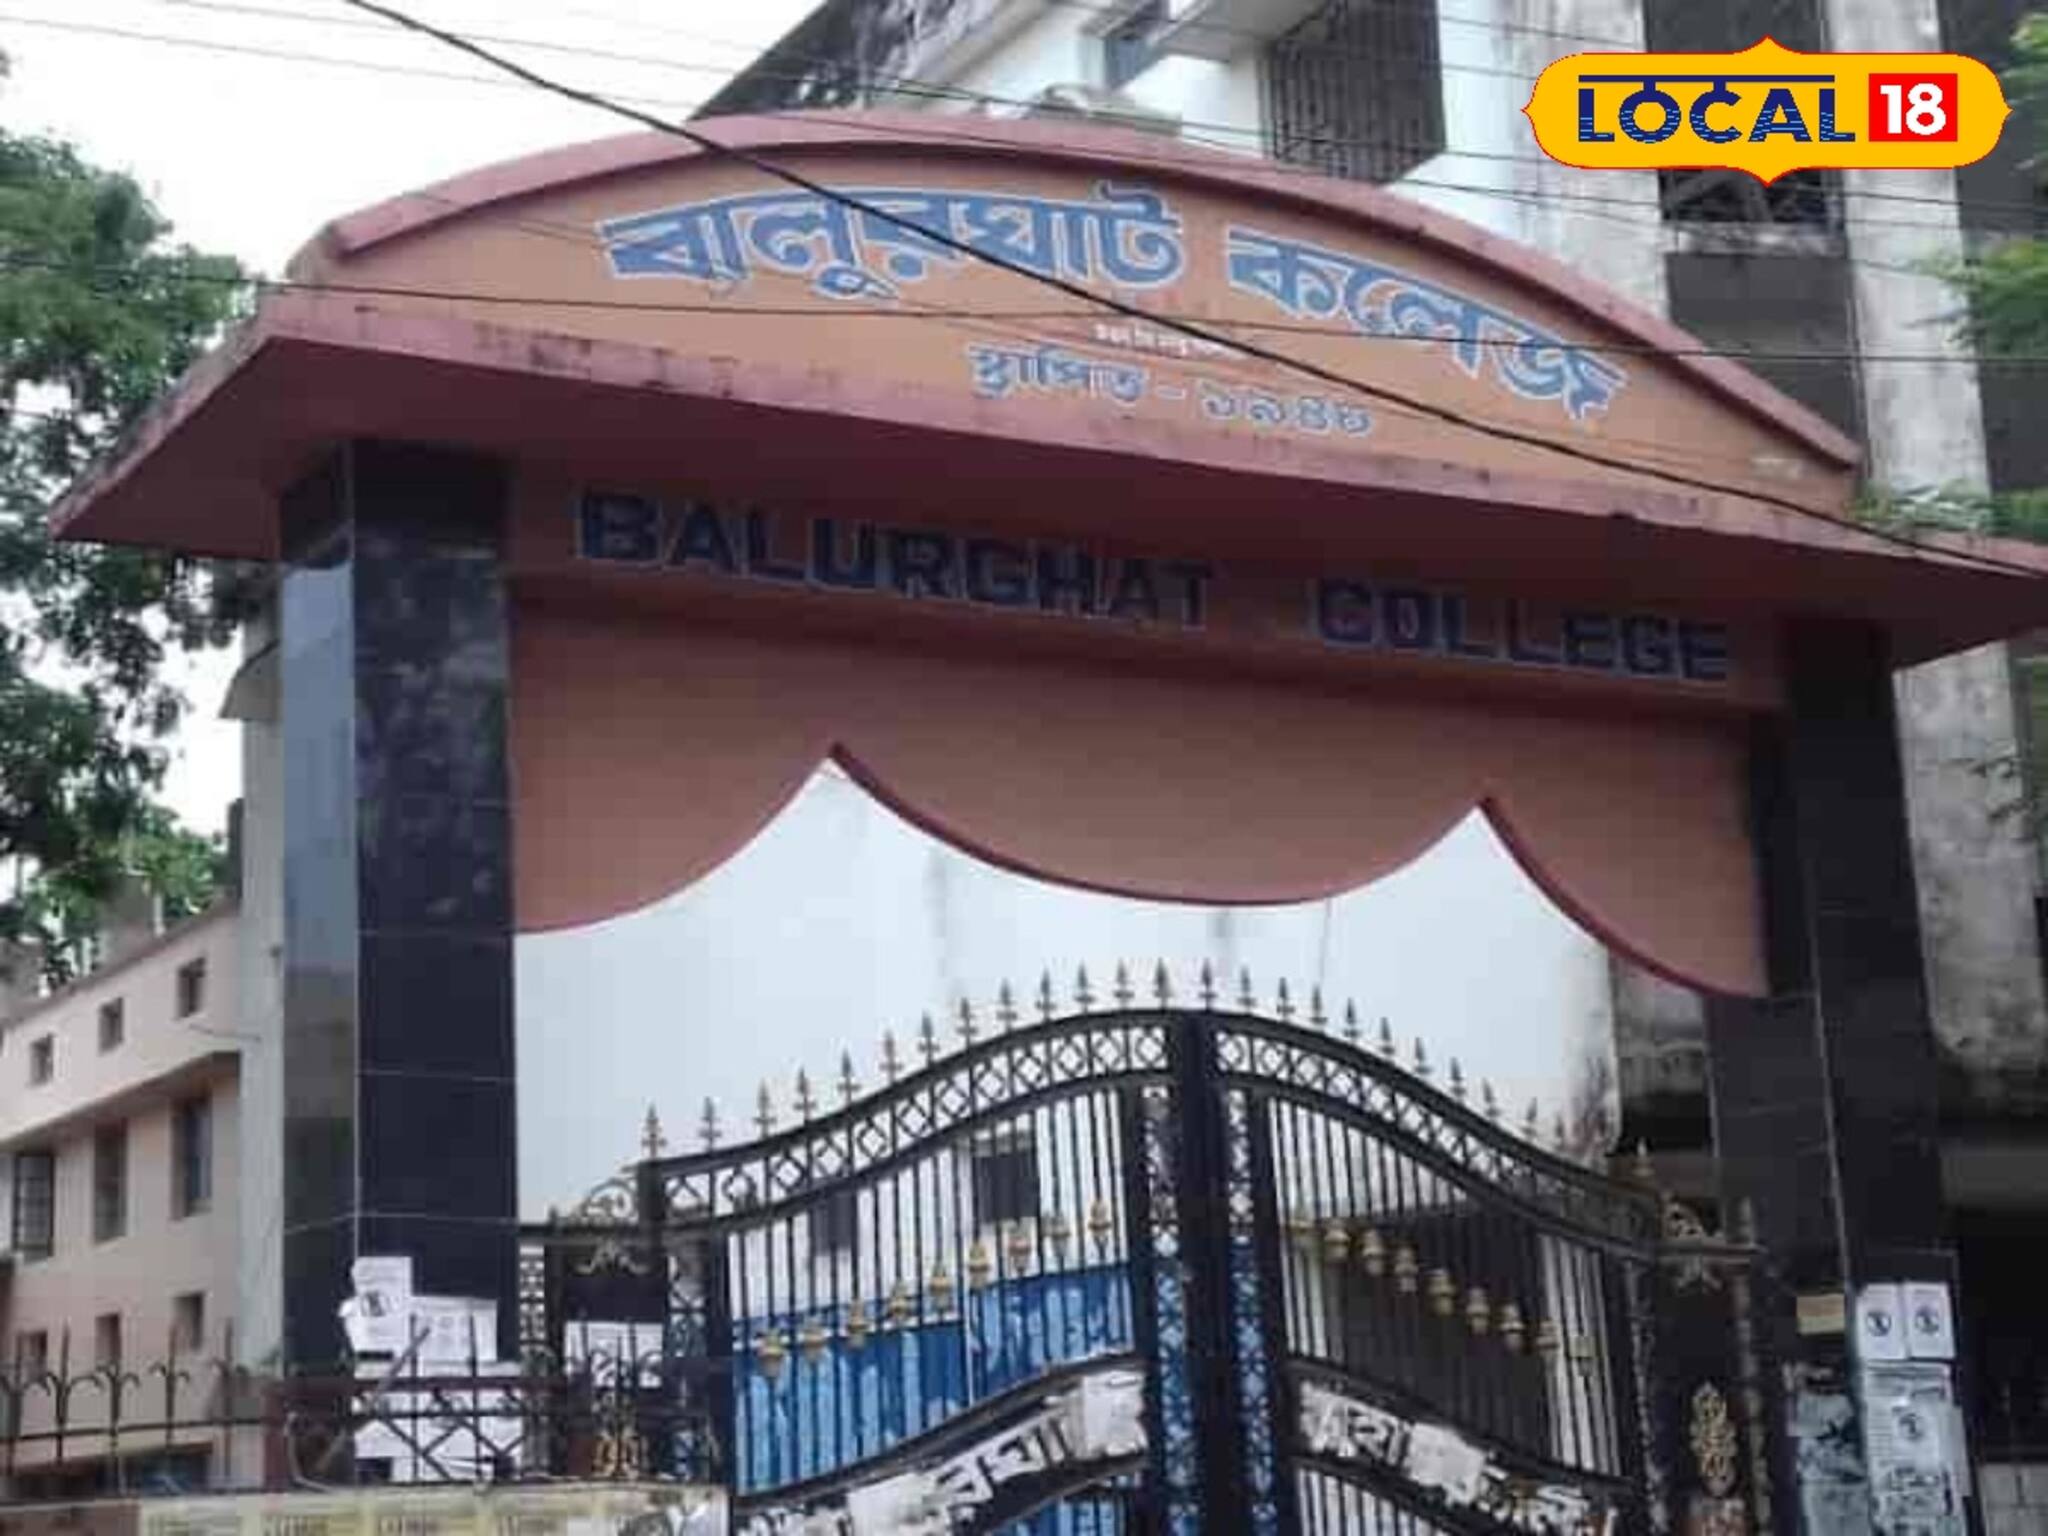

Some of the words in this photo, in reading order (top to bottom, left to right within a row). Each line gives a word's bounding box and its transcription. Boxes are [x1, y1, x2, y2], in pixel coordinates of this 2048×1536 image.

[595, 181, 1187, 301] বালুরঘাট
[1226, 224, 1629, 422] কলেজ
[966, 342, 1149, 407] স্থাপিত
[575, 490, 1214, 632] BALURGHAT
[1307, 576, 1729, 685] COLLEGE
